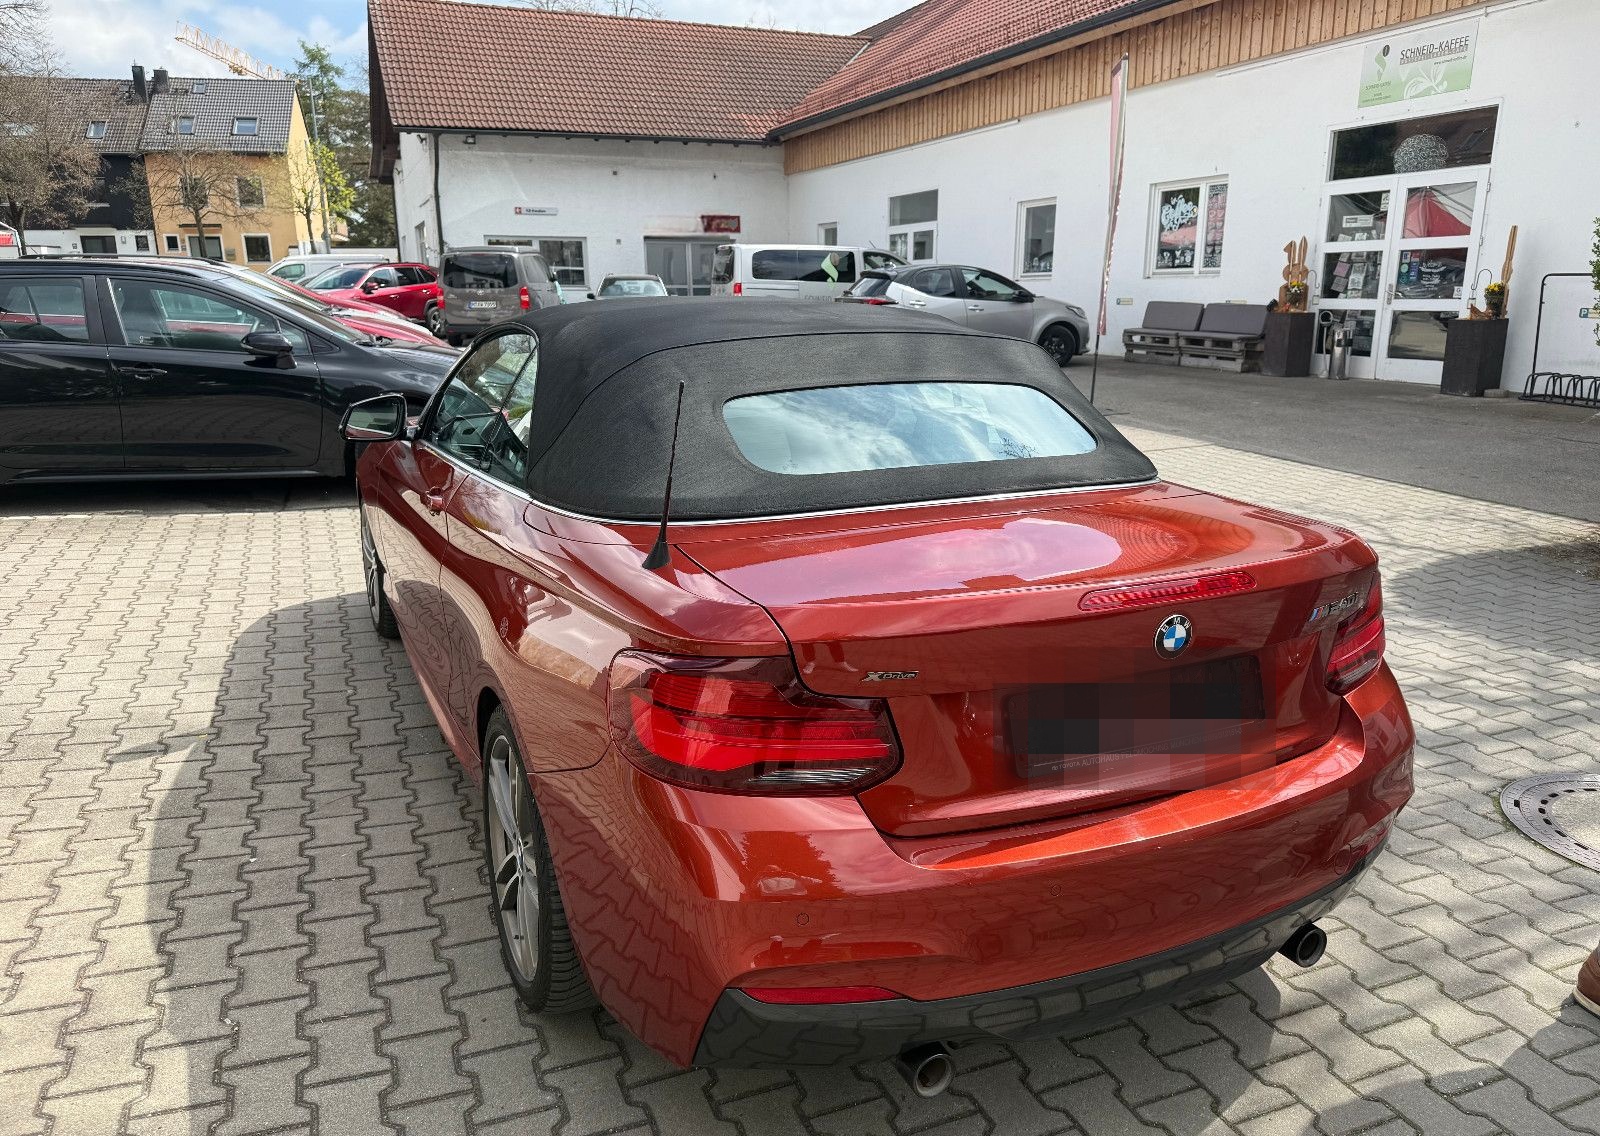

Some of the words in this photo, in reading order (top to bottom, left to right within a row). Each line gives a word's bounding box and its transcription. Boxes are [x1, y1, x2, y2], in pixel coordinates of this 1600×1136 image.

[1400, 36, 1470, 60] SCHNEID-KAFFEE
[1161, 617, 1192, 633] BMW
[1059, 761, 1081, 770] TOYOTA
[1082, 752, 1120, 767] AUTOHAUS
